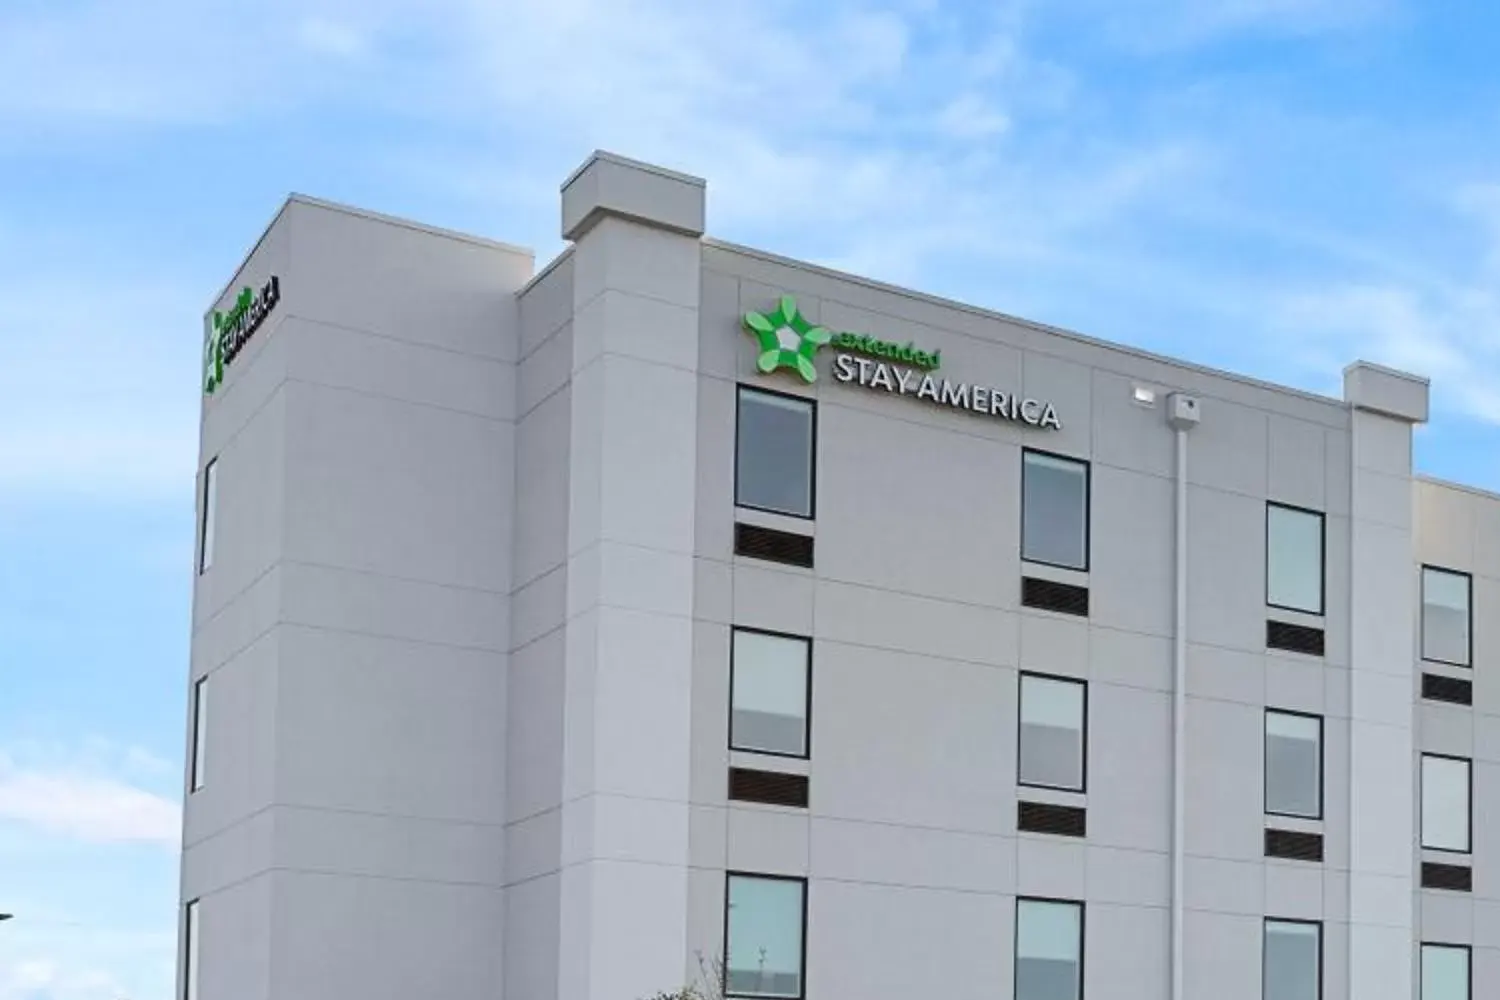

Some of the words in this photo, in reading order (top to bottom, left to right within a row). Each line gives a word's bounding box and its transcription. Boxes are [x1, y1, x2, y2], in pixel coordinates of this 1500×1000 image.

[836, 332, 941, 371] extended
[835, 353, 912, 393] STAY
[916, 374, 1061, 430] AMERICA
